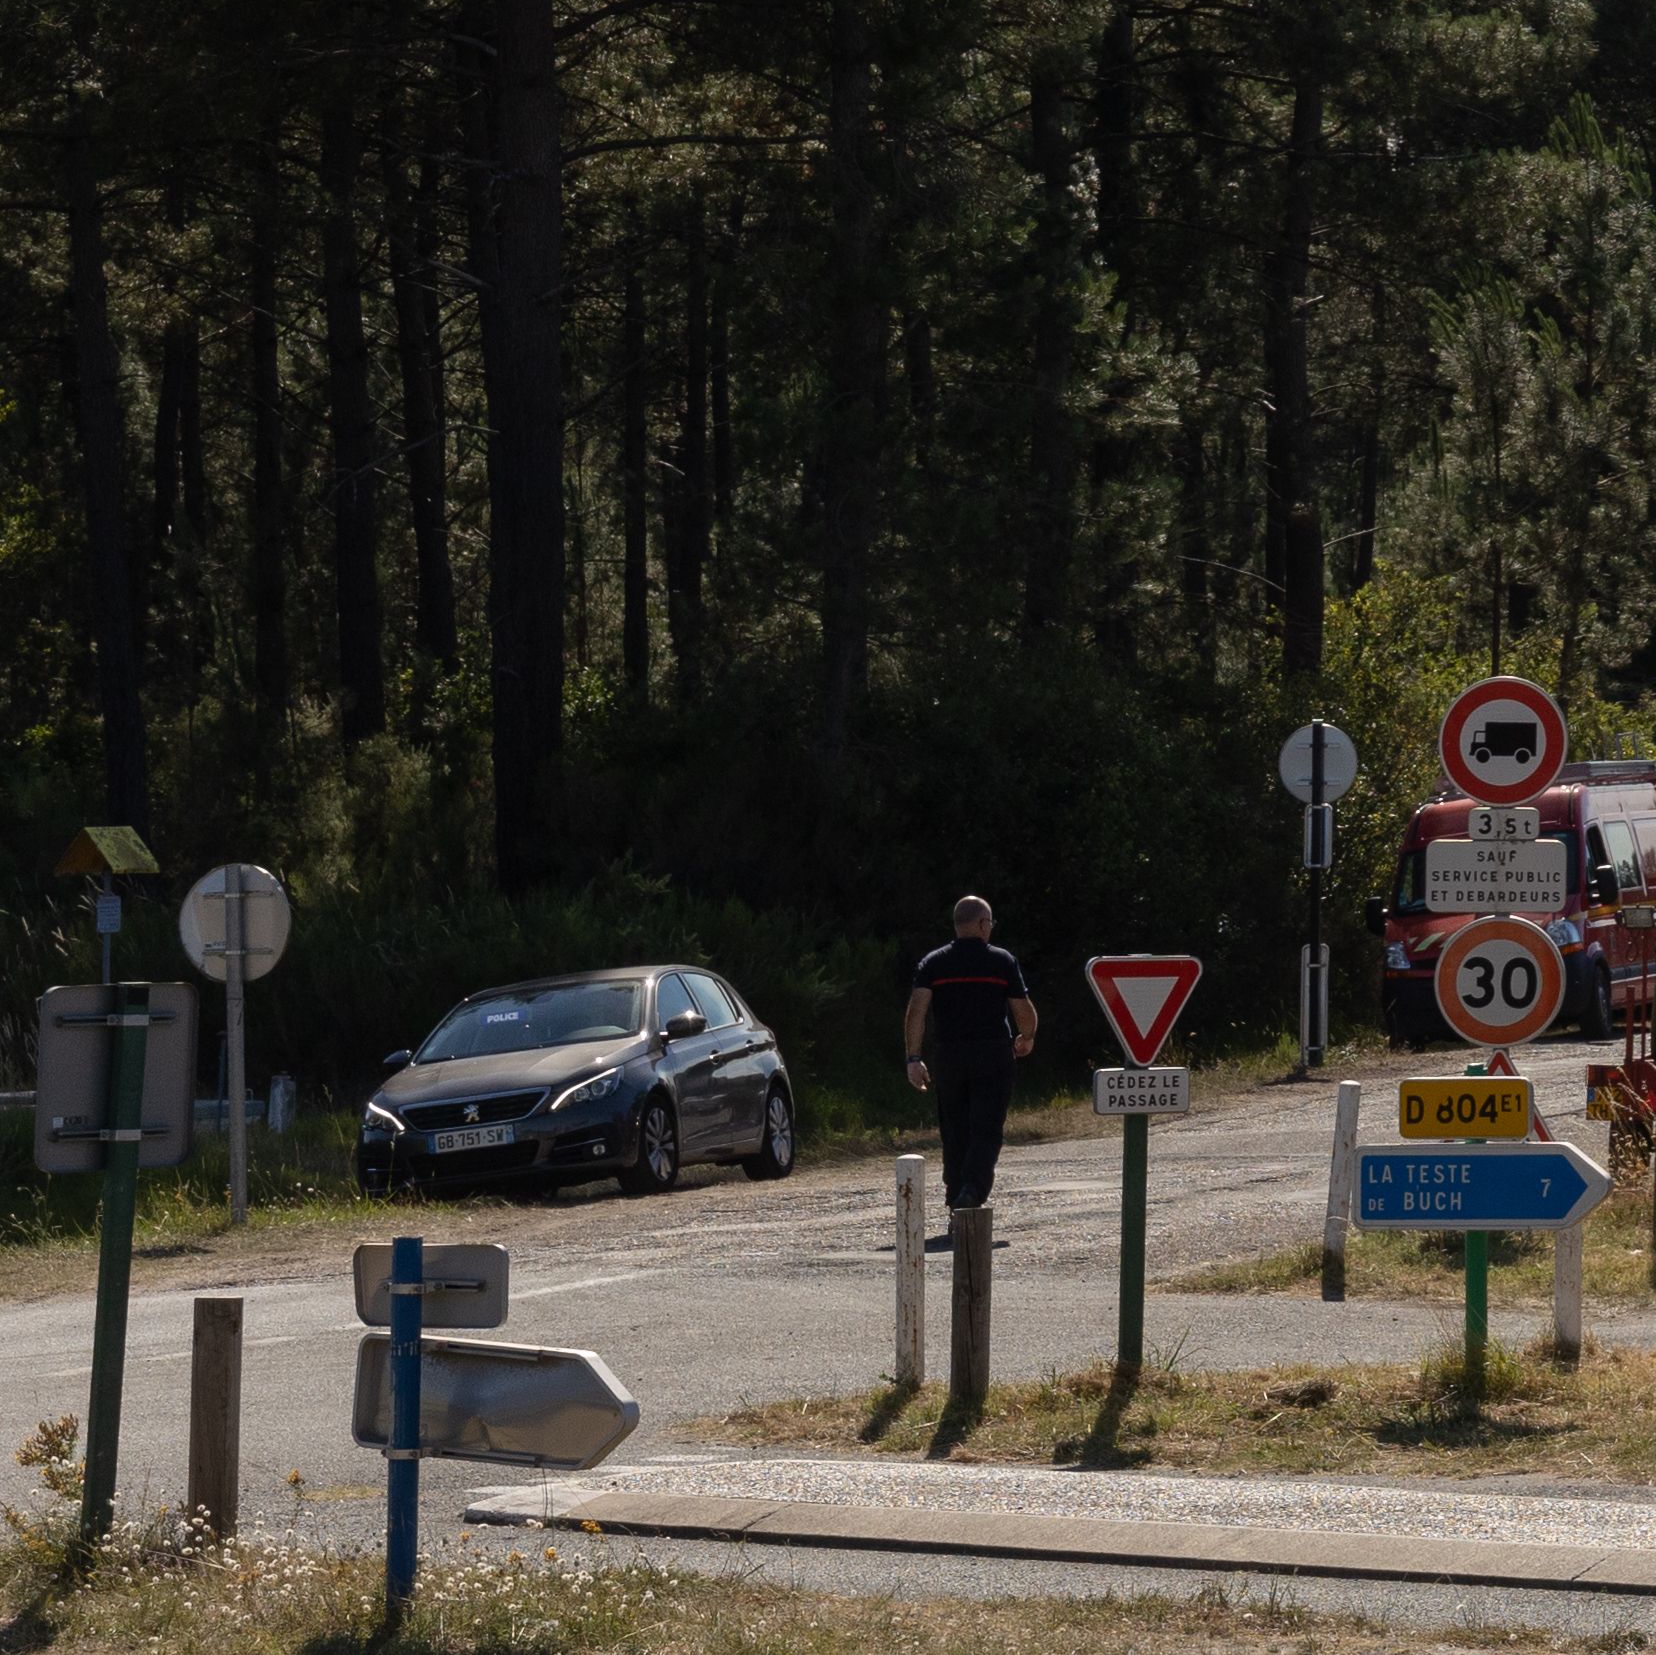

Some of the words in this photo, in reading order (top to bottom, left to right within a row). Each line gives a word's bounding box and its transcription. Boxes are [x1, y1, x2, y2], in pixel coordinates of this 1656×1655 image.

[1478, 813, 1517, 838] 3,5
[1524, 819, 1532, 835] t
[1476, 849, 1517, 863] SAUF
[1431, 870, 1499, 882] SERVICE
[1505, 871, 1561, 883] PUBLIC
[1431, 890, 1448, 902] ET
[1456, 890, 1561, 903] DEBARDEURS
[1461, 956, 1538, 1010] 30
[487, 1011, 519, 1024] POLICE
[1107, 1074, 1157, 1090] CÉDEZ
[1163, 1075, 1180, 1088] LE
[1108, 1093, 1178, 1108] PASSAGE
[1406, 1095, 1425, 1125] D
[1368, 1164, 1393, 1184] LA
[1406, 1164, 1471, 1184] TESTE
[1540, 1179, 1552, 1198] 7
[1368, 1198, 1385, 1211] DE
[1403, 1191, 1462, 1211] BUCH
